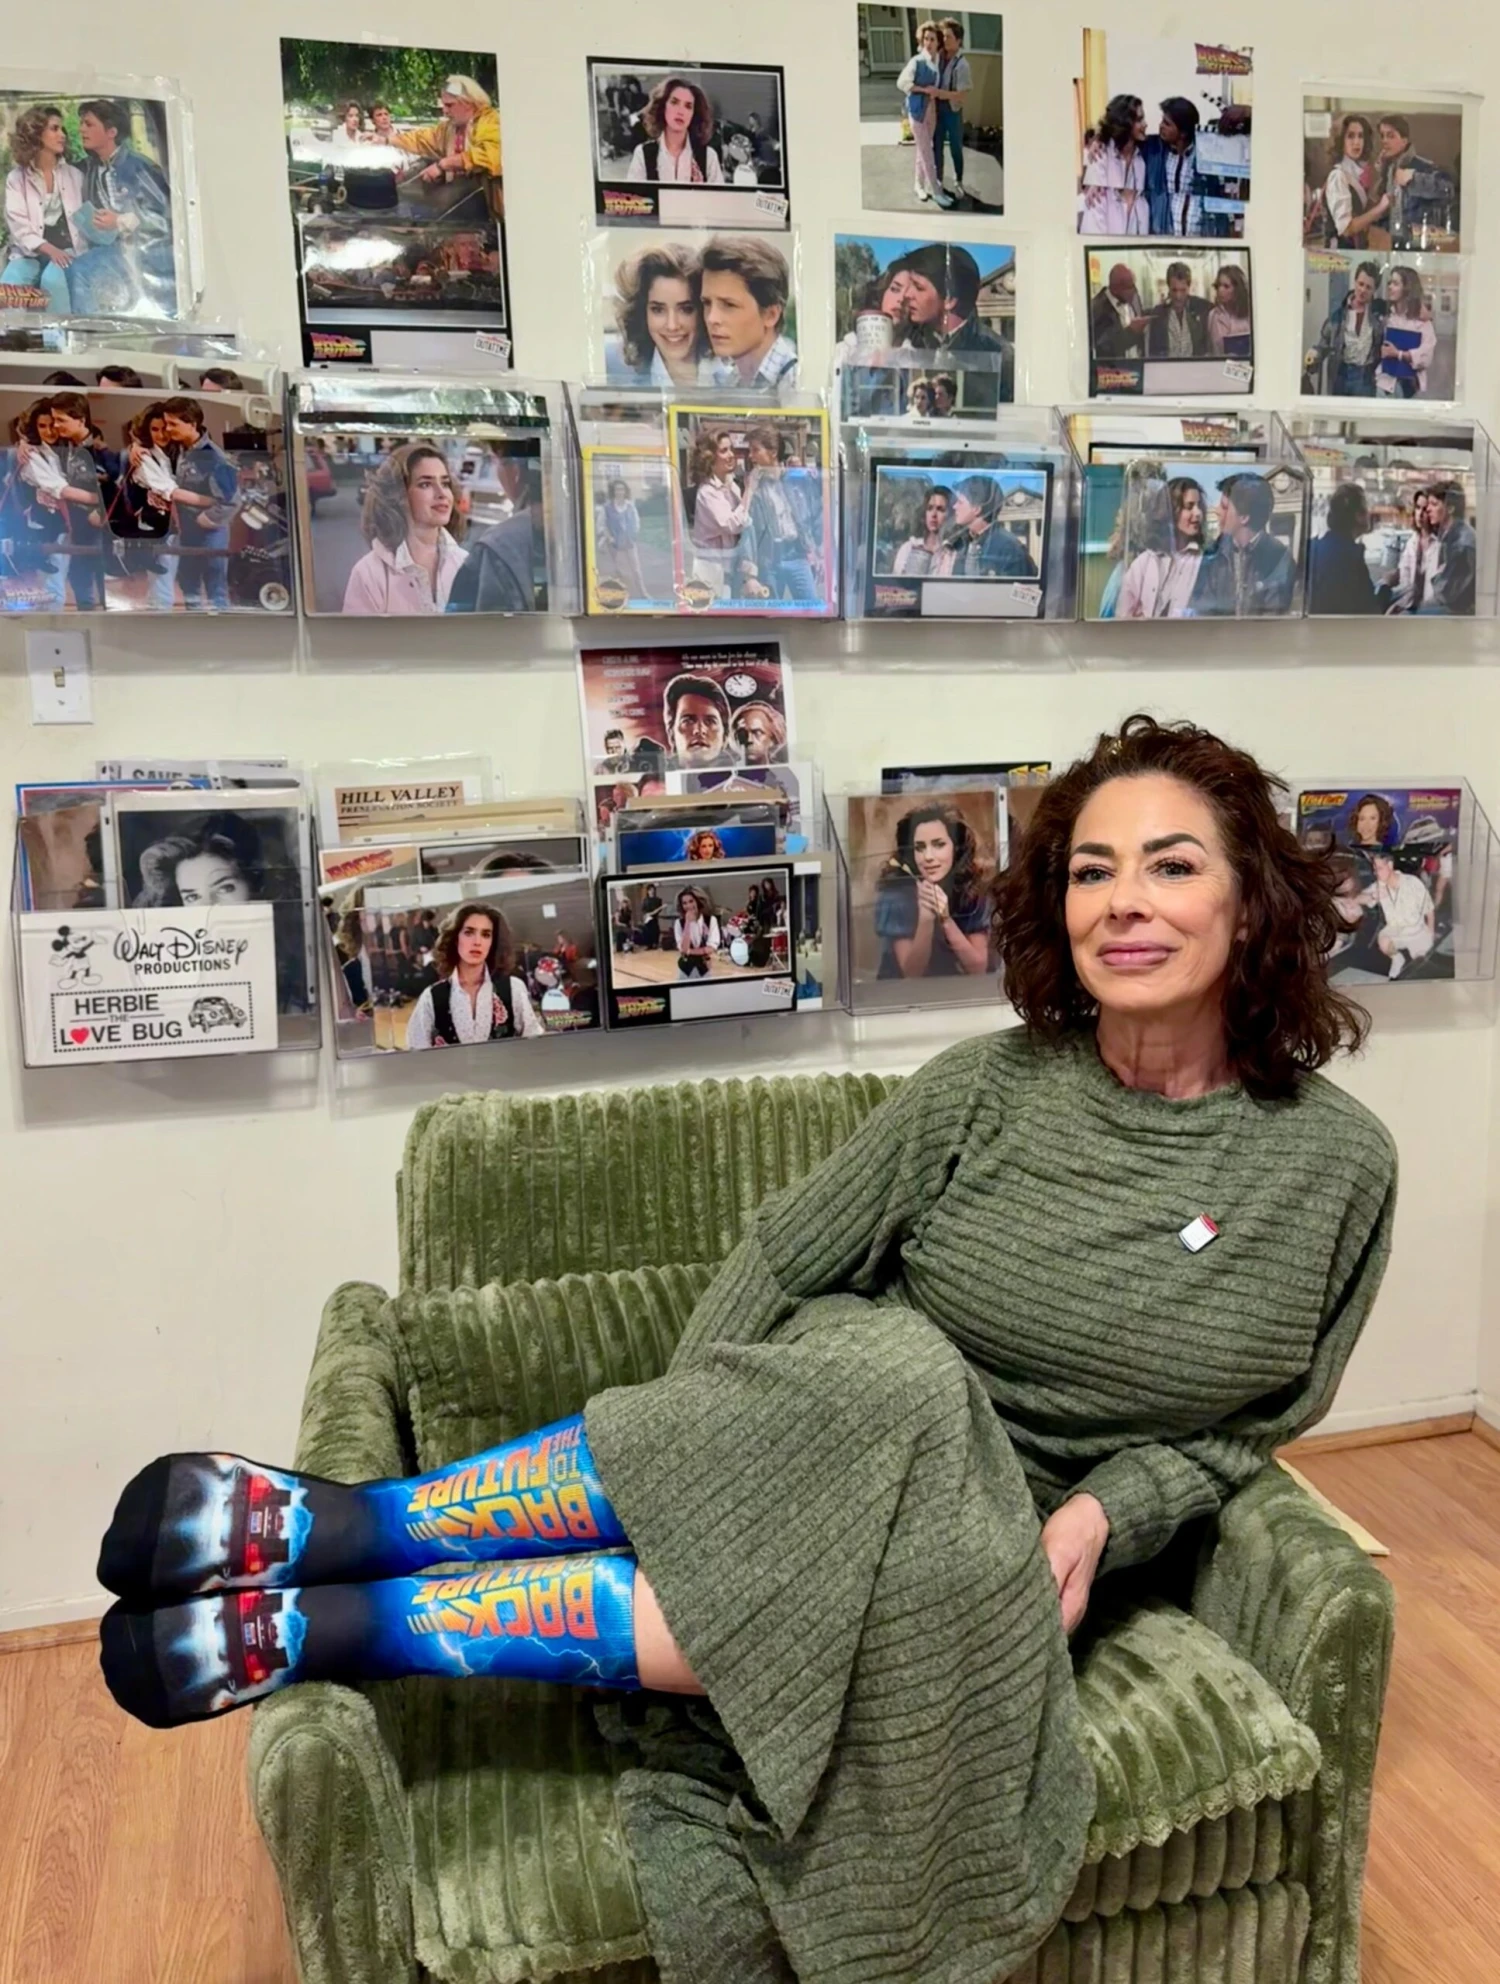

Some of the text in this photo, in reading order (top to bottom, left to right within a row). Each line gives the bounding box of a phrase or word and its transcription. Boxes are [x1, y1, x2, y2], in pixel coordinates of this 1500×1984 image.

[341, 785, 460, 805] HILL VALLEY
[415, 799, 458, 810] SOCIETY
[134, 958, 231, 975] PRODUCTIONS
[75, 993, 159, 1015] HERBIE
[109, 1013, 129, 1024] THE
[132, 1020, 183, 1041] BUG
[407, 1424, 583, 1513] TO THE FUTURE
[441, 1483, 600, 1539] BACK
[411, 1560, 567, 1605] FUTURE
[447, 1570, 600, 1640] BACK
